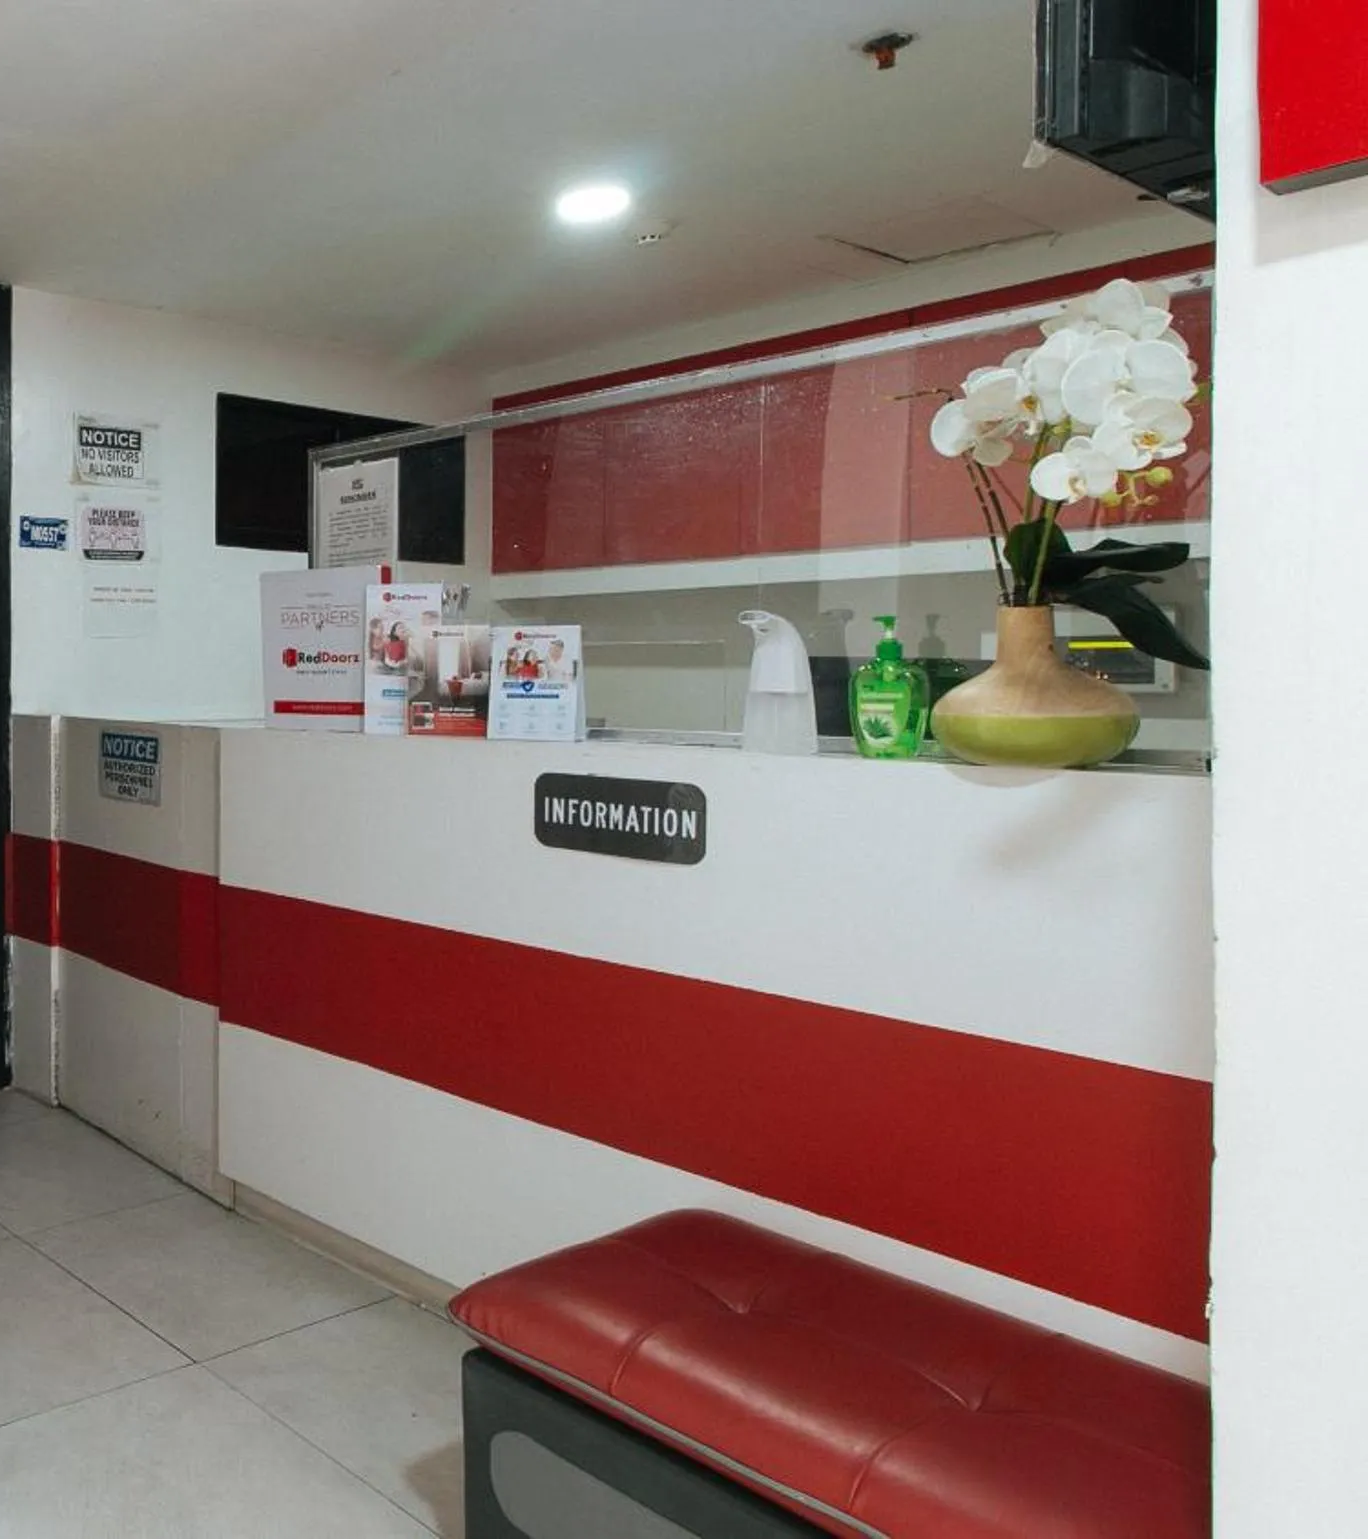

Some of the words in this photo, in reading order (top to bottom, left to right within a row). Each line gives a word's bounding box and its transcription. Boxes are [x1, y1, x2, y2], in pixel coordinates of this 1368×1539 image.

[81, 429, 139, 448] NOTICE
[80, 447, 96, 460] NO
[97, 449, 140, 464] VISITORS
[89, 463, 134, 478] ALLOWED
[280, 609, 360, 626] PARTNERS
[298, 651, 360, 664] RedDoorz
[103, 735, 157, 759] NOTICE
[103, 759, 156, 776] AUTHORIZED
[118, 785, 140, 798] ONLY
[543, 796, 697, 840] INFORMATION
